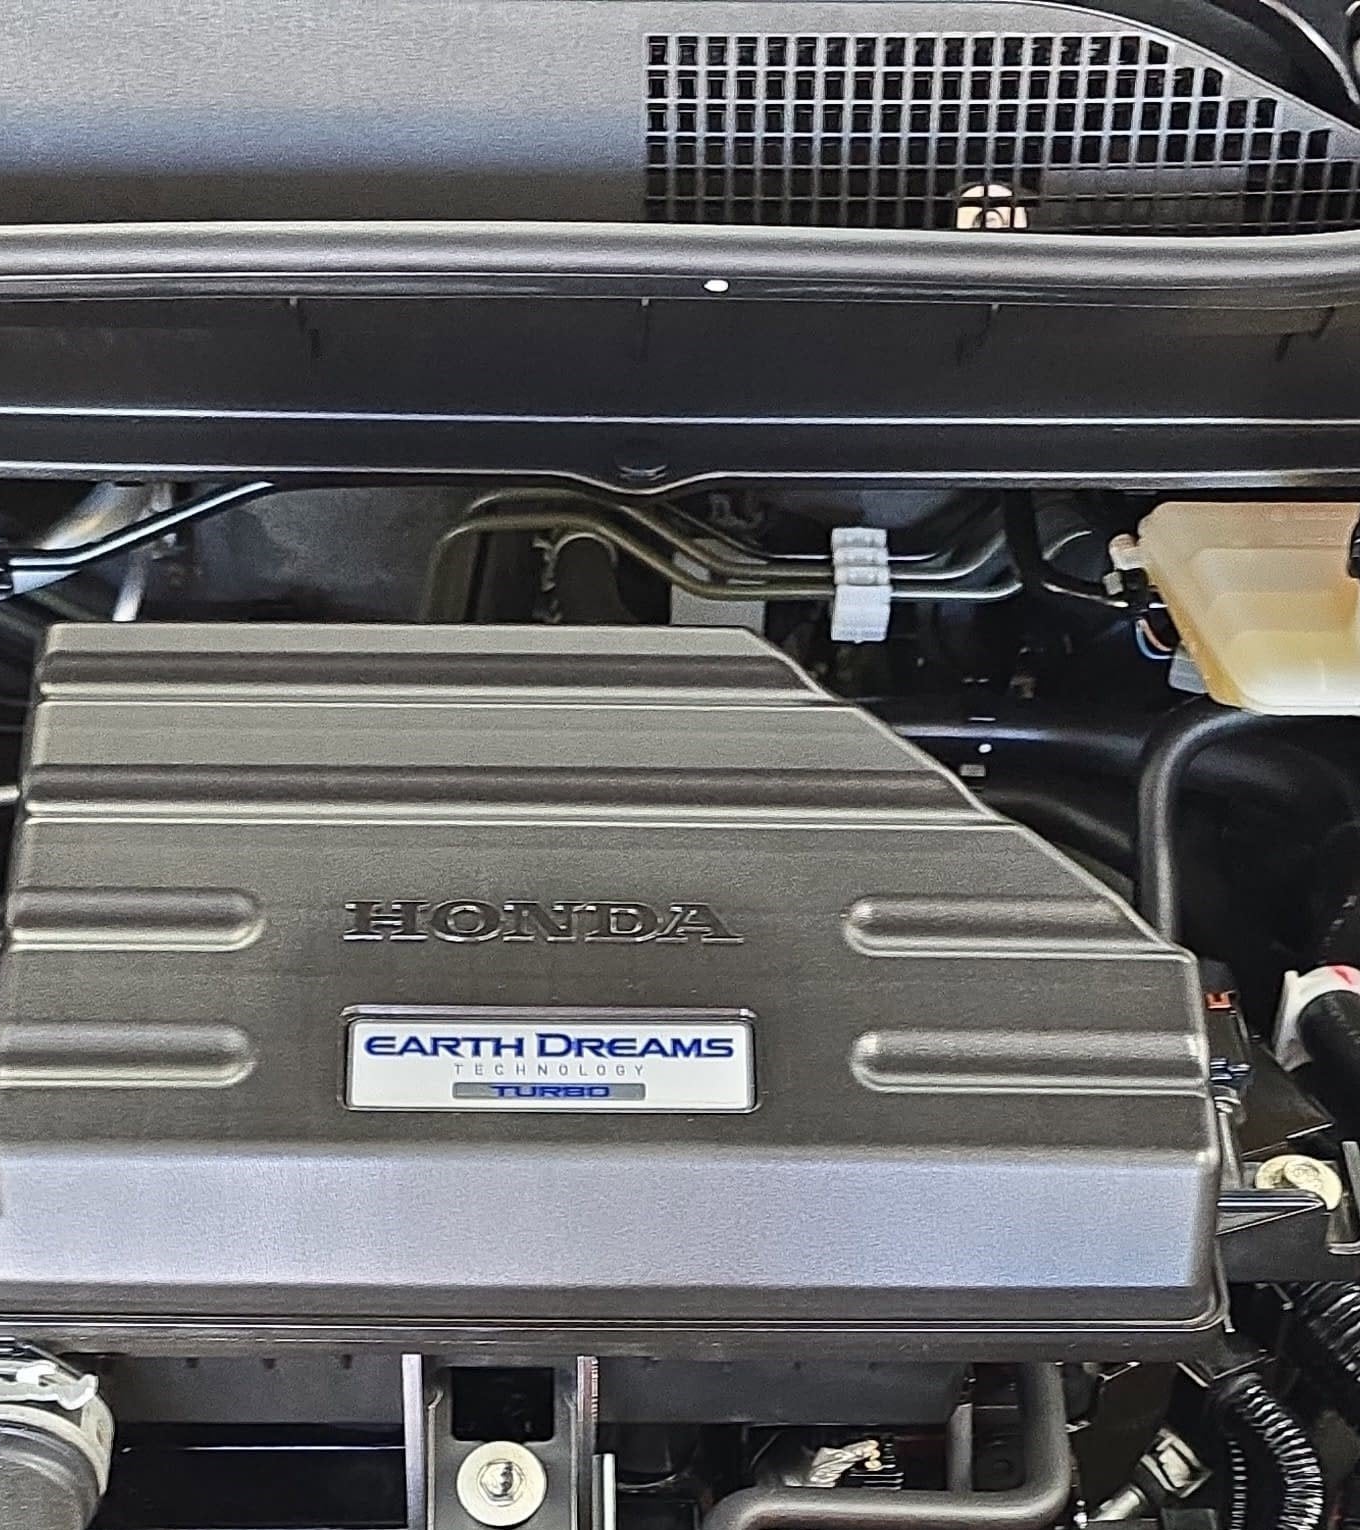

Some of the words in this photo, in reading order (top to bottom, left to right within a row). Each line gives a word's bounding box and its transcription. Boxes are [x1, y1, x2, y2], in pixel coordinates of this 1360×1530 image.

[342, 900, 745, 943] HONDA
[364, 1035, 525, 1057] EARTH
[536, 1032, 734, 1058] DREAMS
[454, 1062, 645, 1077] TECHNOLOGY
[491, 1085, 611, 1099] TURBO
